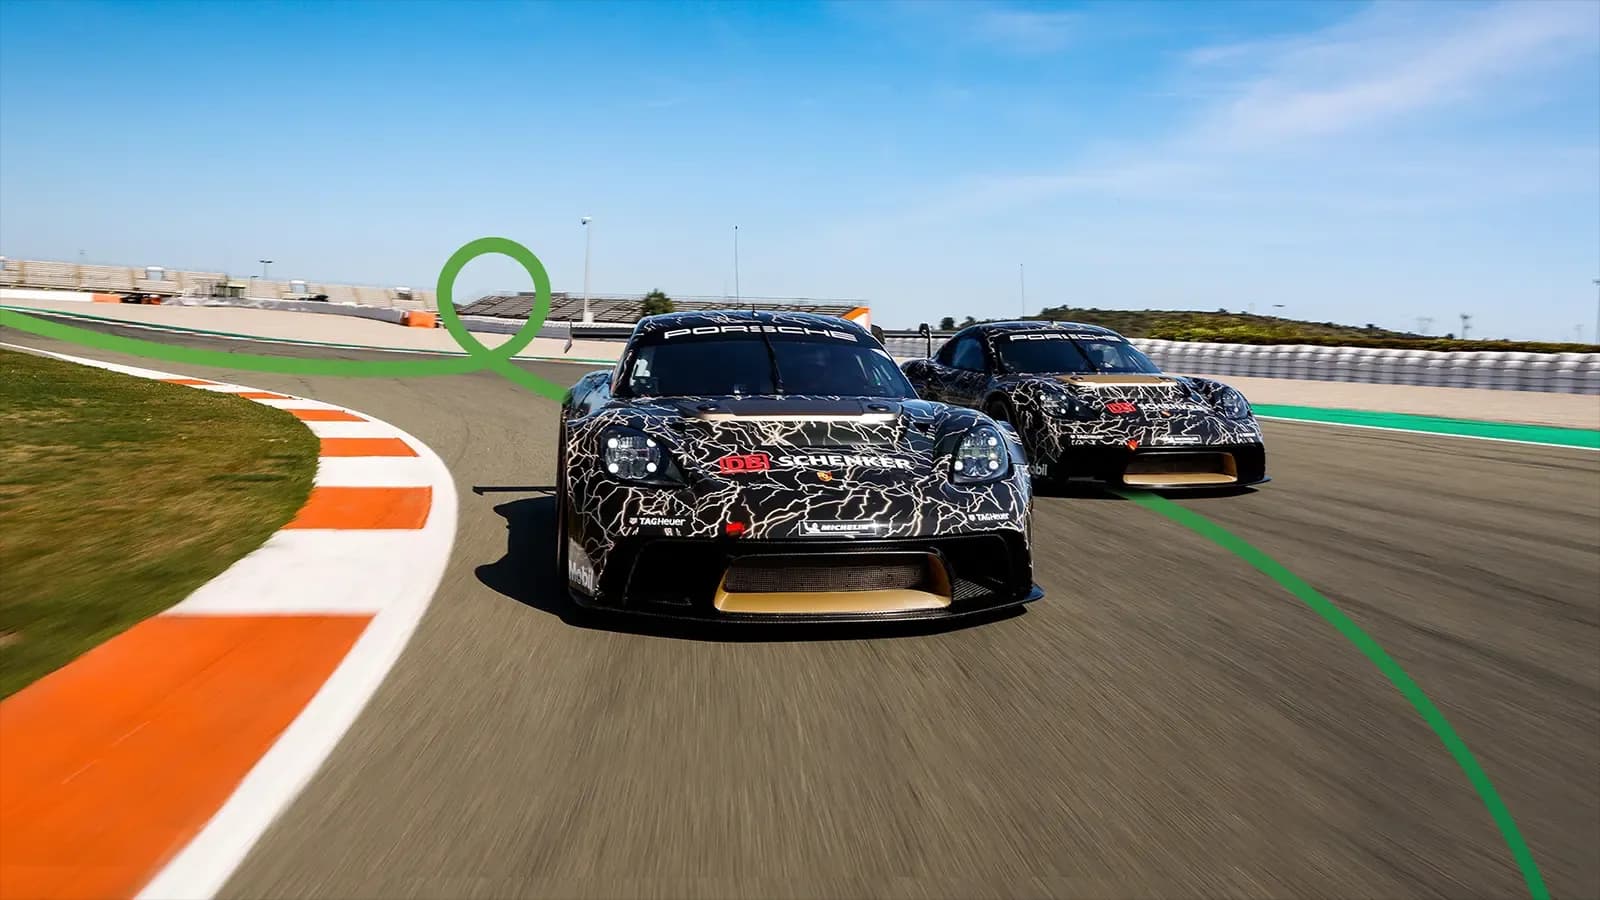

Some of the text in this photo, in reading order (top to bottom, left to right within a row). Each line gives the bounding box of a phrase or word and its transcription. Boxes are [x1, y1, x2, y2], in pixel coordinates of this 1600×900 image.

[664, 325, 858, 342] PORSCHE
[1009, 333, 1121, 342] PORSCHE
[725, 455, 912, 471] DB SCHENKER
[1028, 463, 1048, 476] obil
